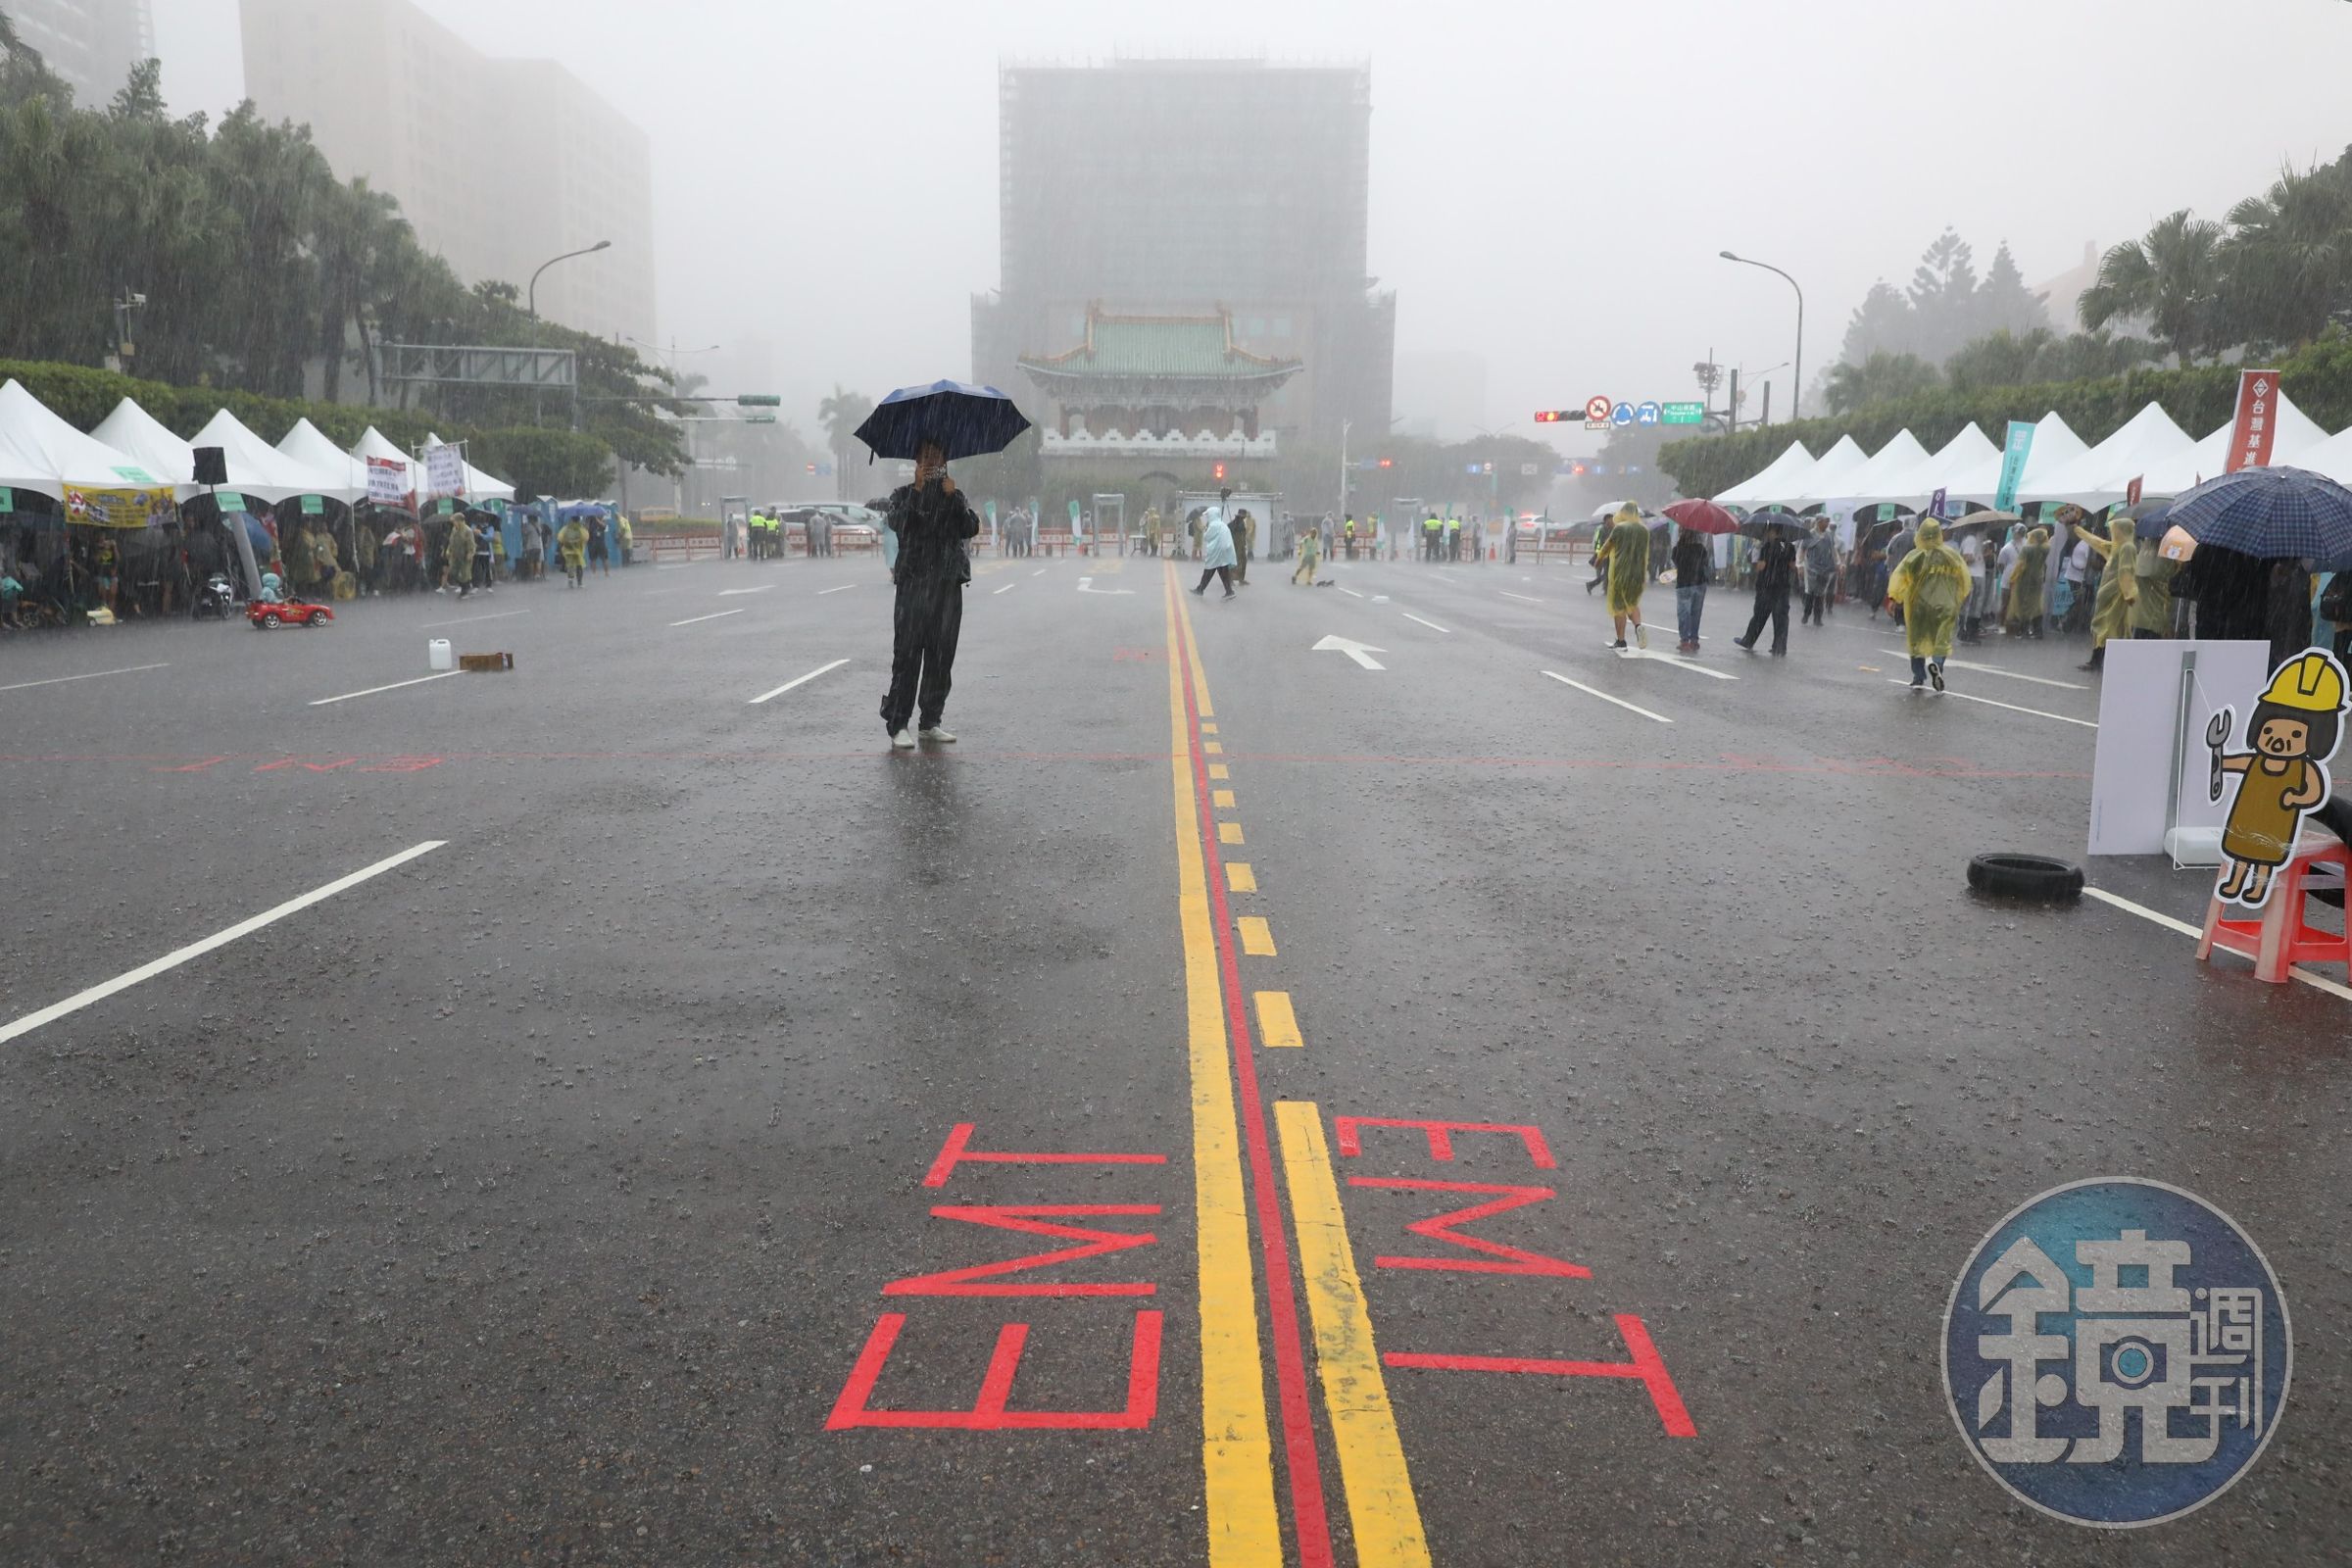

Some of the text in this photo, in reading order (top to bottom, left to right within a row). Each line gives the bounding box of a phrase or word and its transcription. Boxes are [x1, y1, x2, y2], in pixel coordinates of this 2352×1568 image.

[2243, 399, 2265, 466] 台灣基進
[825, 1123, 1166, 1430] EMT
[1334, 1115, 1697, 1438] EMT
